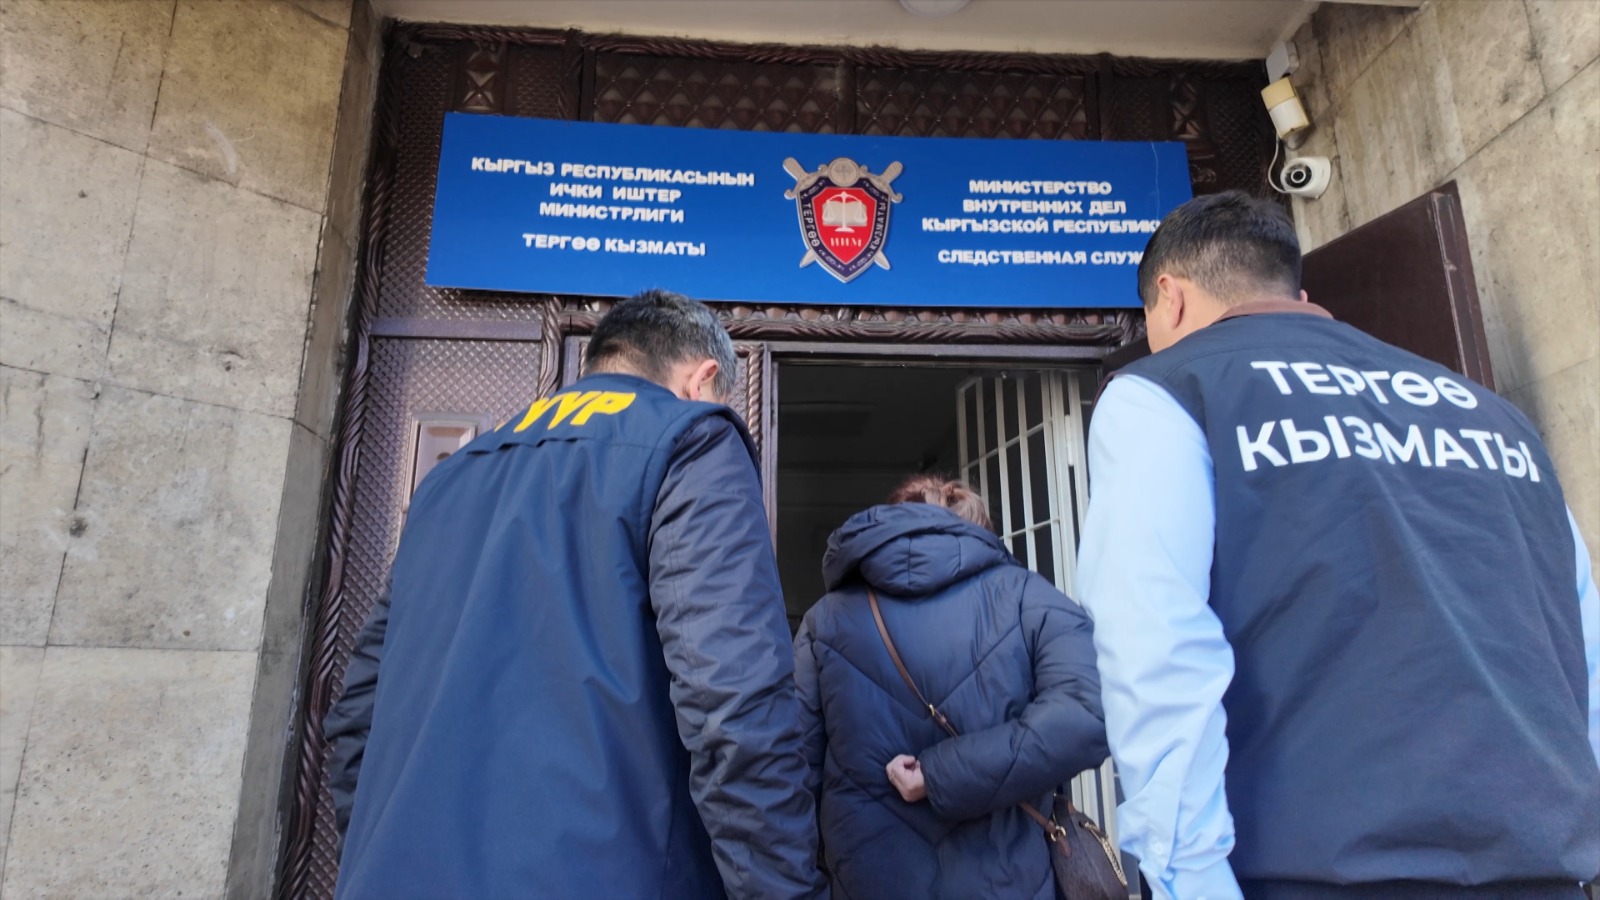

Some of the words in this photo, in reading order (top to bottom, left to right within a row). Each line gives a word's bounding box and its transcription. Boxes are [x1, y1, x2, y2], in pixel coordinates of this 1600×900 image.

[472, 158, 554, 175] КЫРГЫЗ
[561, 163, 755, 187] РЕСПУБЛИКАСЫНЫН
[550, 183, 602, 198] ИЧКИ
[613, 187, 681, 202] ИШТЕР
[969, 180, 1111, 194] МИНИСТЕРСТВО
[540, 200, 683, 222] МИНИСТРЛИГИ
[963, 200, 1083, 213] ВНУТРЕННИХ
[1089, 201, 1126, 215] ДЕЛ
[803, 202, 820, 247] ТЕРГӨӨ
[869, 202, 887, 250] КЫЗМАТЫ
[922, 217, 1048, 232] КЫРГЫЗСКОЙ
[523, 234, 600, 251] ТЕРГӨӨ
[605, 238, 705, 255] КЫЗМАТЫ
[938, 250, 1086, 265] СЛЕДСТВЕННАЯ
[1250, 361, 1478, 409] ТЕРГӨӨ
[494, 391, 636, 433] УУР
[1237, 415, 1540, 482] КЫЗМАТЫ
